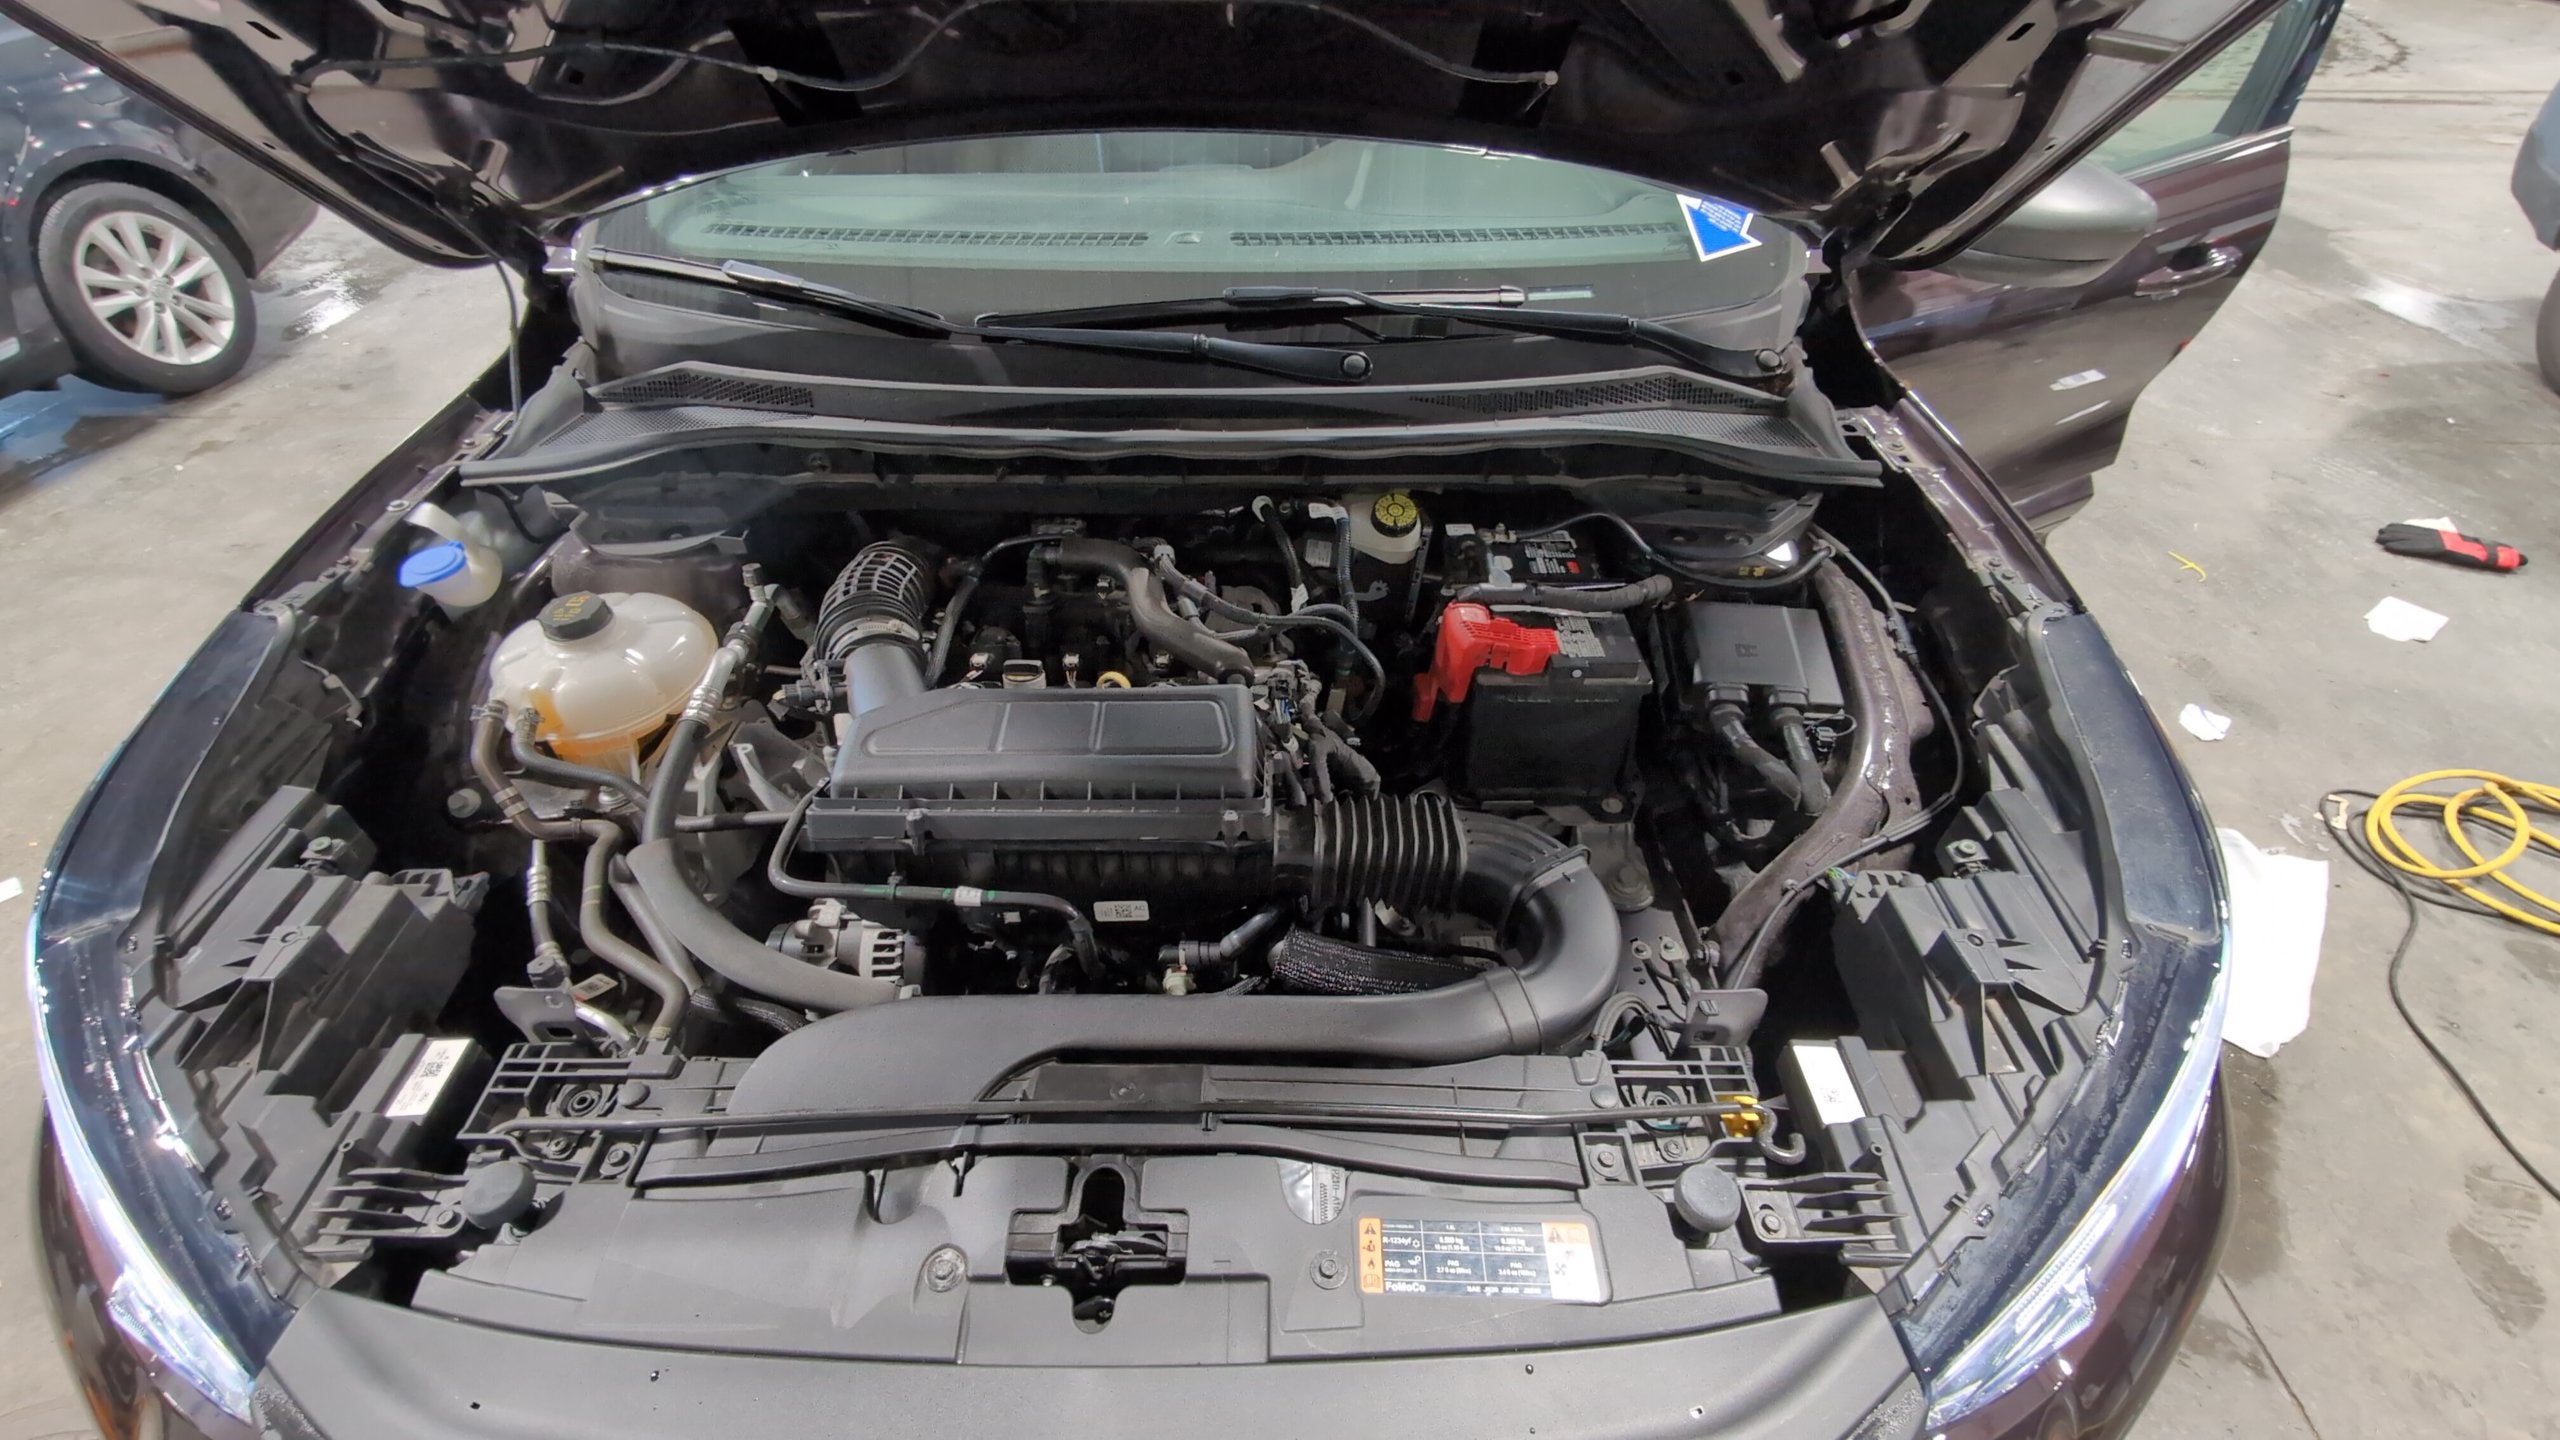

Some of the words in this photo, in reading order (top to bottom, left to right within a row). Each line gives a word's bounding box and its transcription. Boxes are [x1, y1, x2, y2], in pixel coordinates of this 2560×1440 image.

[1382, 1236, 1412, 1246] R-1234yf
[1384, 1260, 1401, 1268] PAG
[1385, 1281, 1426, 1293] FoMoCo
